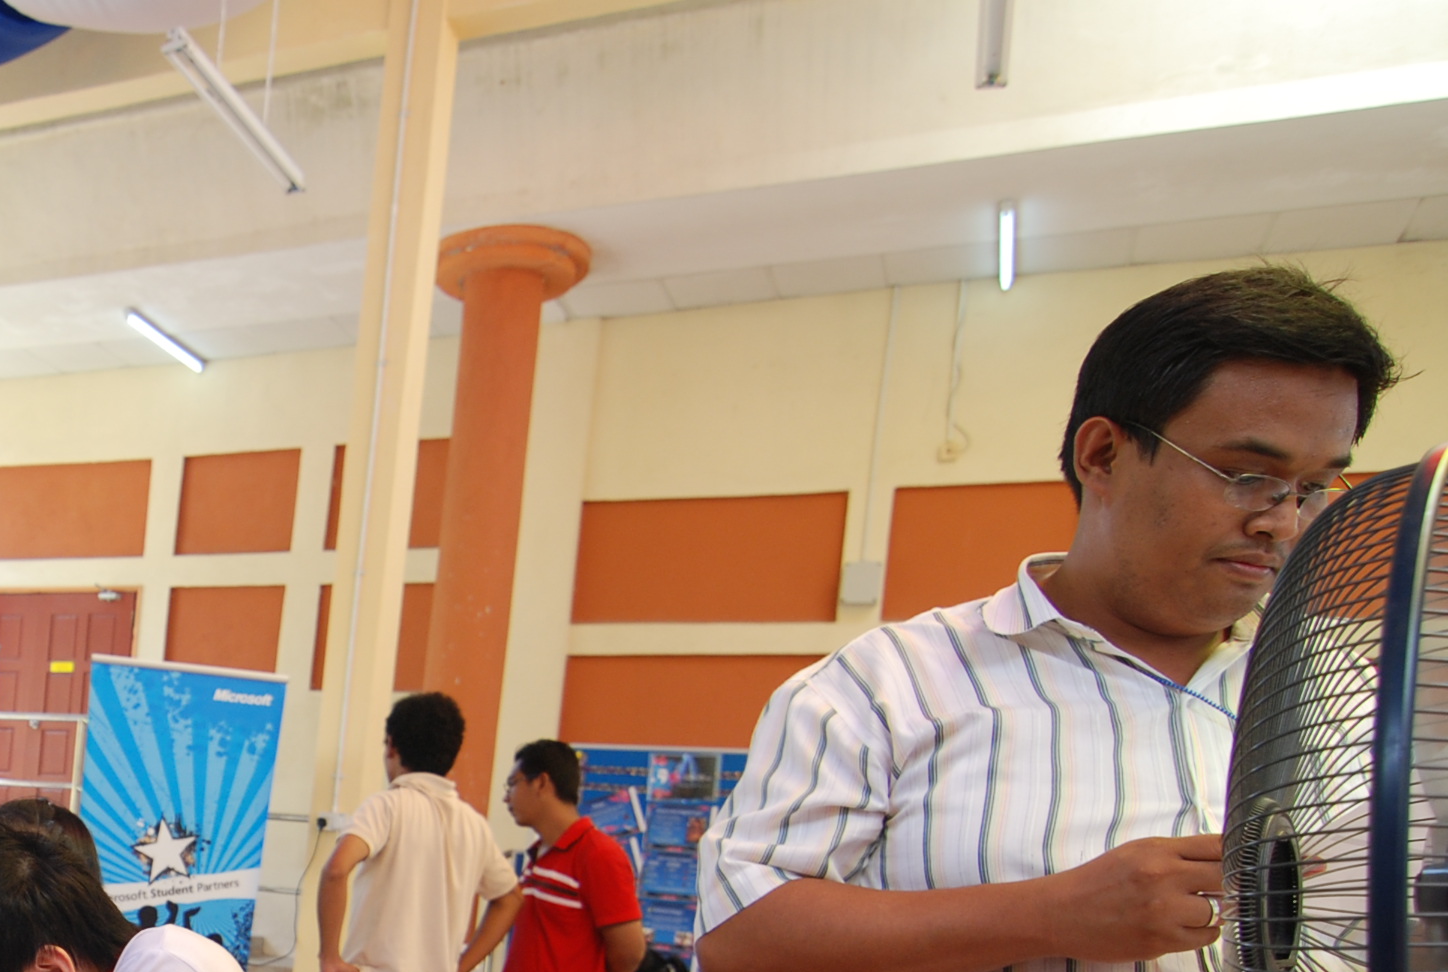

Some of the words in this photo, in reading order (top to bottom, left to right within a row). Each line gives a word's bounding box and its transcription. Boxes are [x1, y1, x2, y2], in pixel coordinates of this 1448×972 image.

[213, 688, 273, 707] Microsoft
[150, 884, 193, 899] Student
[197, 879, 239, 893] Partners
